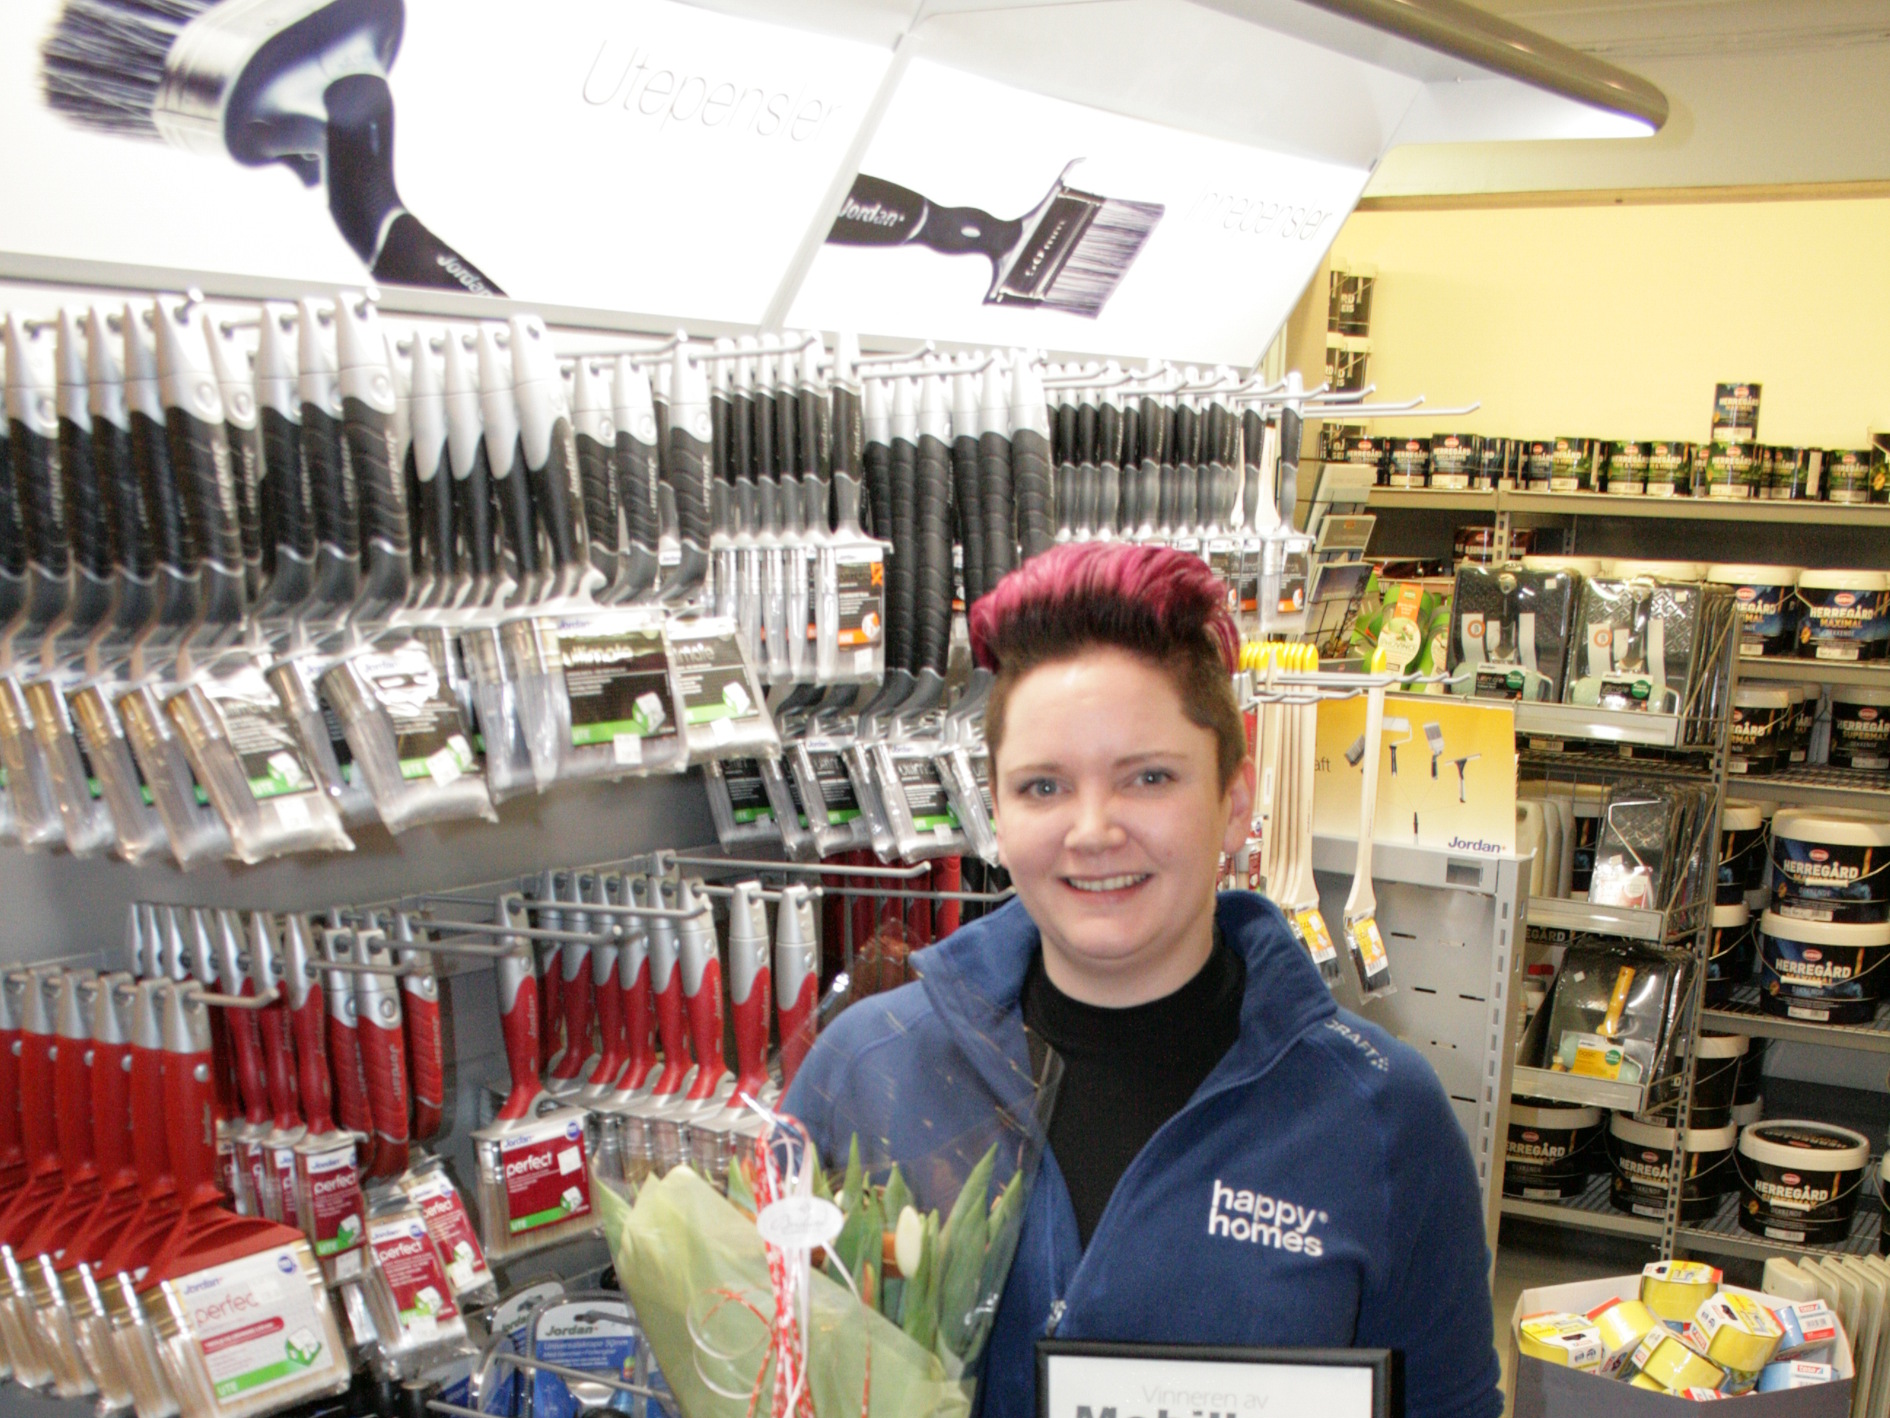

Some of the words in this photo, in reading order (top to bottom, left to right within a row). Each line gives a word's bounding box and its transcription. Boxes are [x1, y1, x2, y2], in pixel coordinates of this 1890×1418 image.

[583, 40, 842, 142] Utepensler
[1809, 604, 1874, 620] HERREGÅRD
[1448, 836, 1502, 854] Jordan
[1783, 858, 1859, 880] HERREGÅRD
[1775, 957, 1852, 979] HERREGÅRD
[506, 1151, 553, 1178] perfect
[1754, 1179, 1829, 1202] HERREGÅRD
[1212, 1179, 1317, 1234] happy
[511, 1219, 528, 1231] UTE
[1208, 1205, 1324, 1258] homes
[379, 1240, 423, 1261] perfect
[195, 1292, 260, 1326] perfec
[545, 1325, 598, 1337] Jordan
